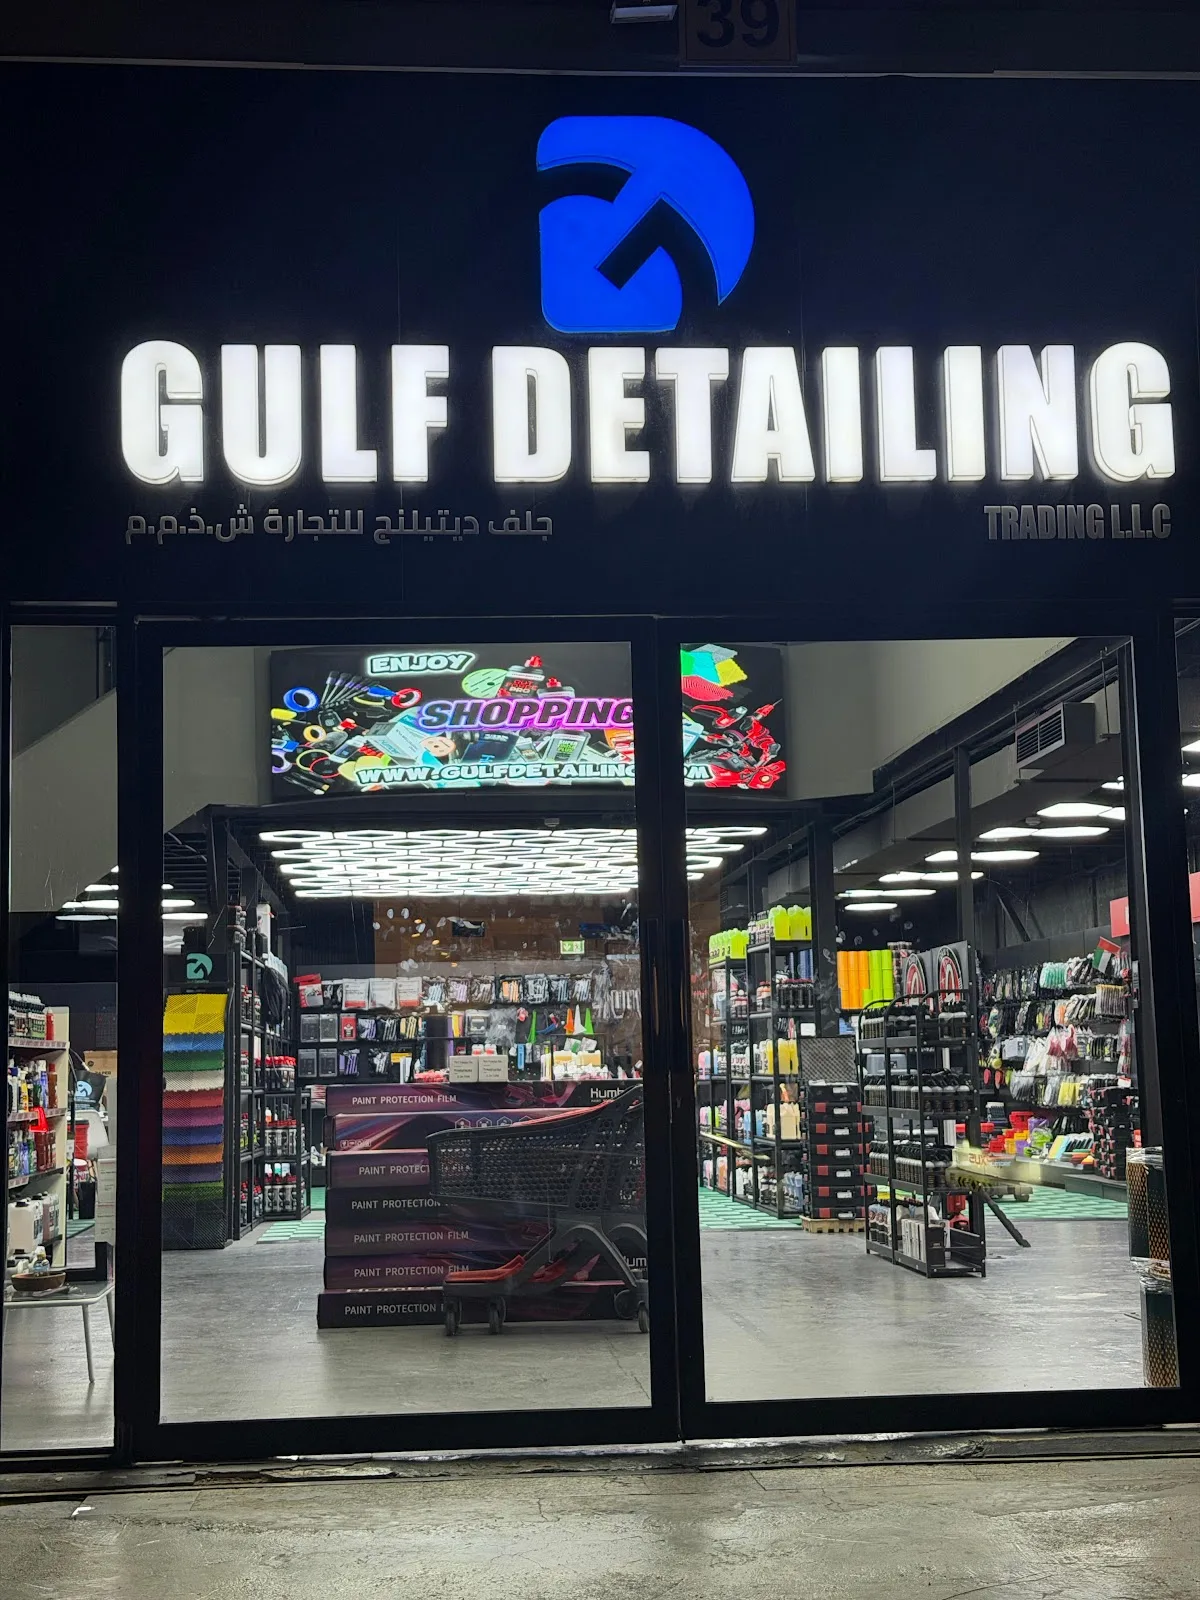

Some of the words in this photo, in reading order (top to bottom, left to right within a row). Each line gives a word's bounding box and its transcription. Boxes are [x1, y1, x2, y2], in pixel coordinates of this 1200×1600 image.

[696, 0, 780, 48] 39
[119, 339, 451, 486] GULF
[491, 341, 1177, 484] DETAILING
[263, 508, 364, 542] للتجارة
[373, 508, 480, 545] ديتيلنج
[488, 508, 553, 542] جلف
[983, 503, 1105, 540] TRADING
[1110, 503, 1172, 539] L.L.C
[369, 653, 470, 674] ENJOY
[352, 1096, 378, 1105] PAINT
[380, 1095, 434, 1104] PROTECTION
[437, 1094, 457, 1103] FILM
[359, 1166, 386, 1175] PAINT
[390, 1164, 430, 1174] PROTECT
[351, 1200, 378, 1209] PAINT
[382, 1198, 441, 1208] PROTECTION
[354, 1234, 380, 1243] PAINT
[384, 1232, 444, 1242] PROTECTION
[447, 1231, 469, 1240] FILM
[354, 1268, 380, 1277] PAINT
[385, 1266, 444, 1276] PROTECTION
[345, 1306, 372, 1315] PAINT
[376, 1304, 437, 1314] PROTECTION
